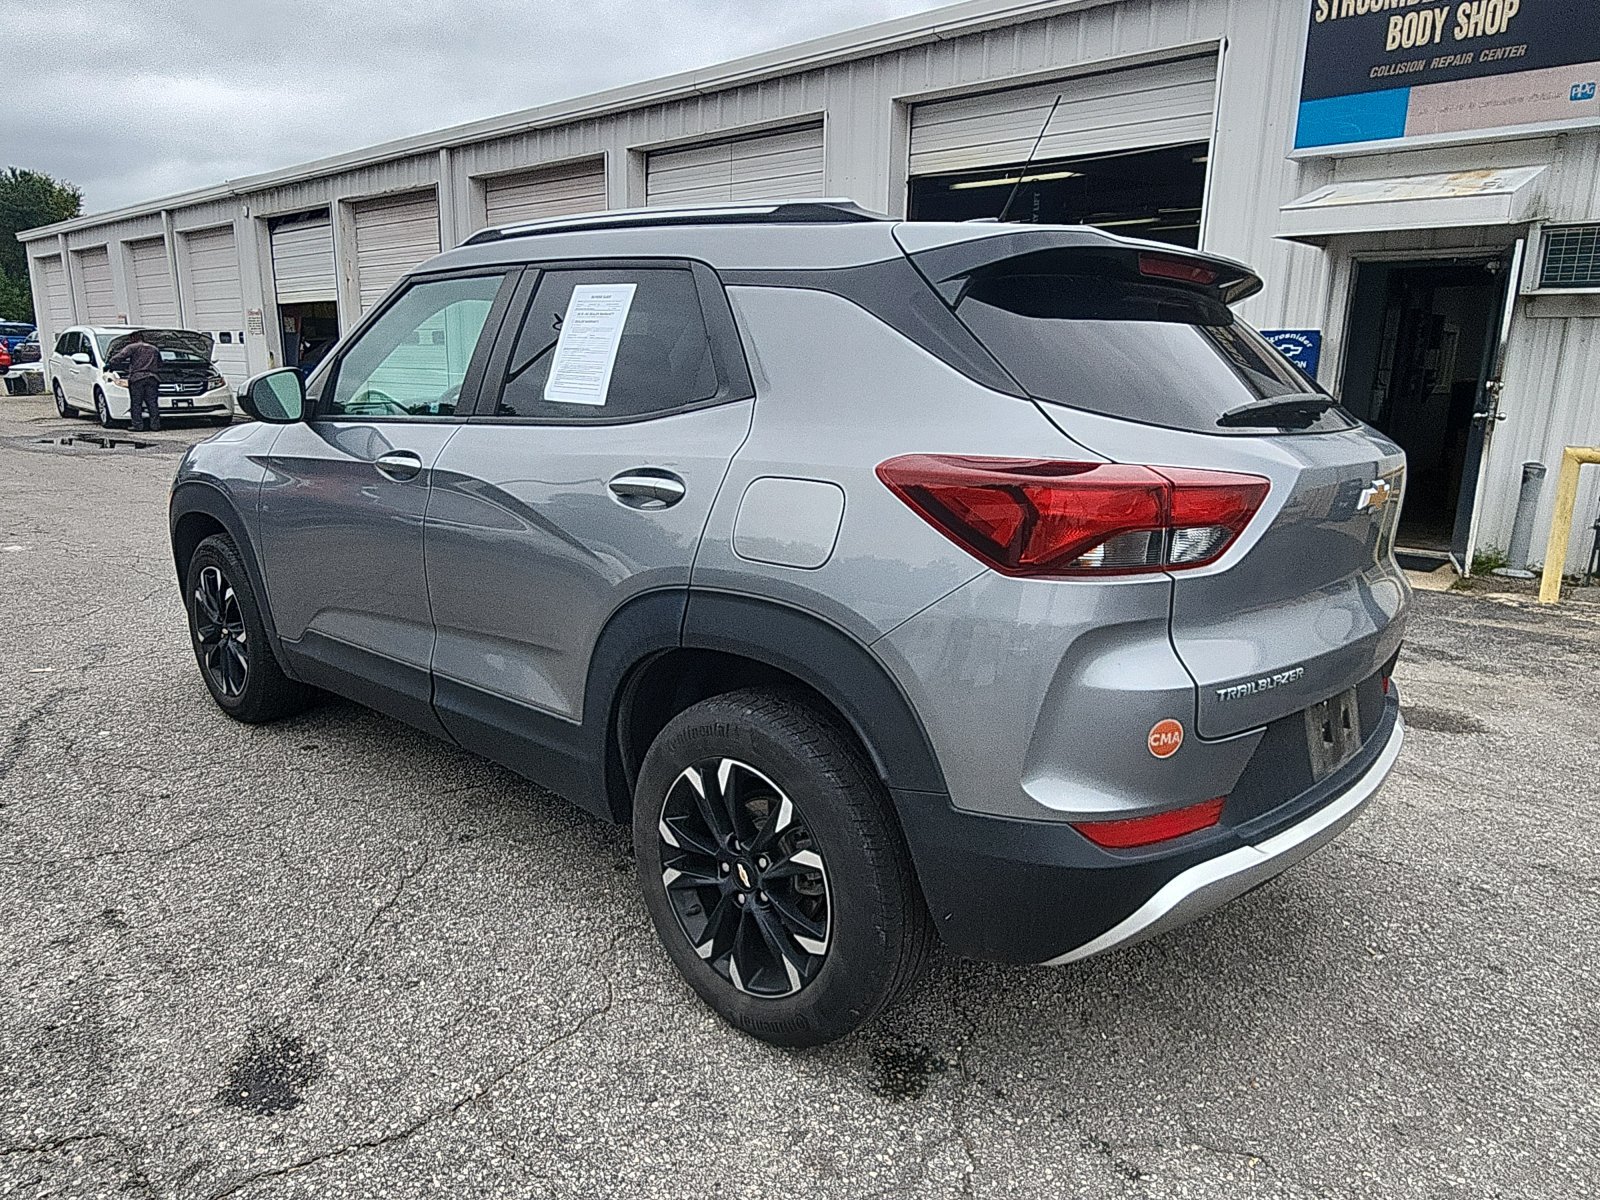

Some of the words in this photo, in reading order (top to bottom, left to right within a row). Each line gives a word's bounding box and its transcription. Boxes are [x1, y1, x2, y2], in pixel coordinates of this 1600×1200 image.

[1386, 6, 1450, 51] BODY
[1454, 0, 1520, 40] SHOP
[1370, 59, 1426, 78] COLLISION
[1430, 52, 1474, 69] REPAIR
[1479, 44, 1528, 62] CENTER
[1572, 83, 1595, 98] PPG
[1216, 667, 1304, 702] TRAILBLAZER
[1150, 731, 1180, 747] CMA
